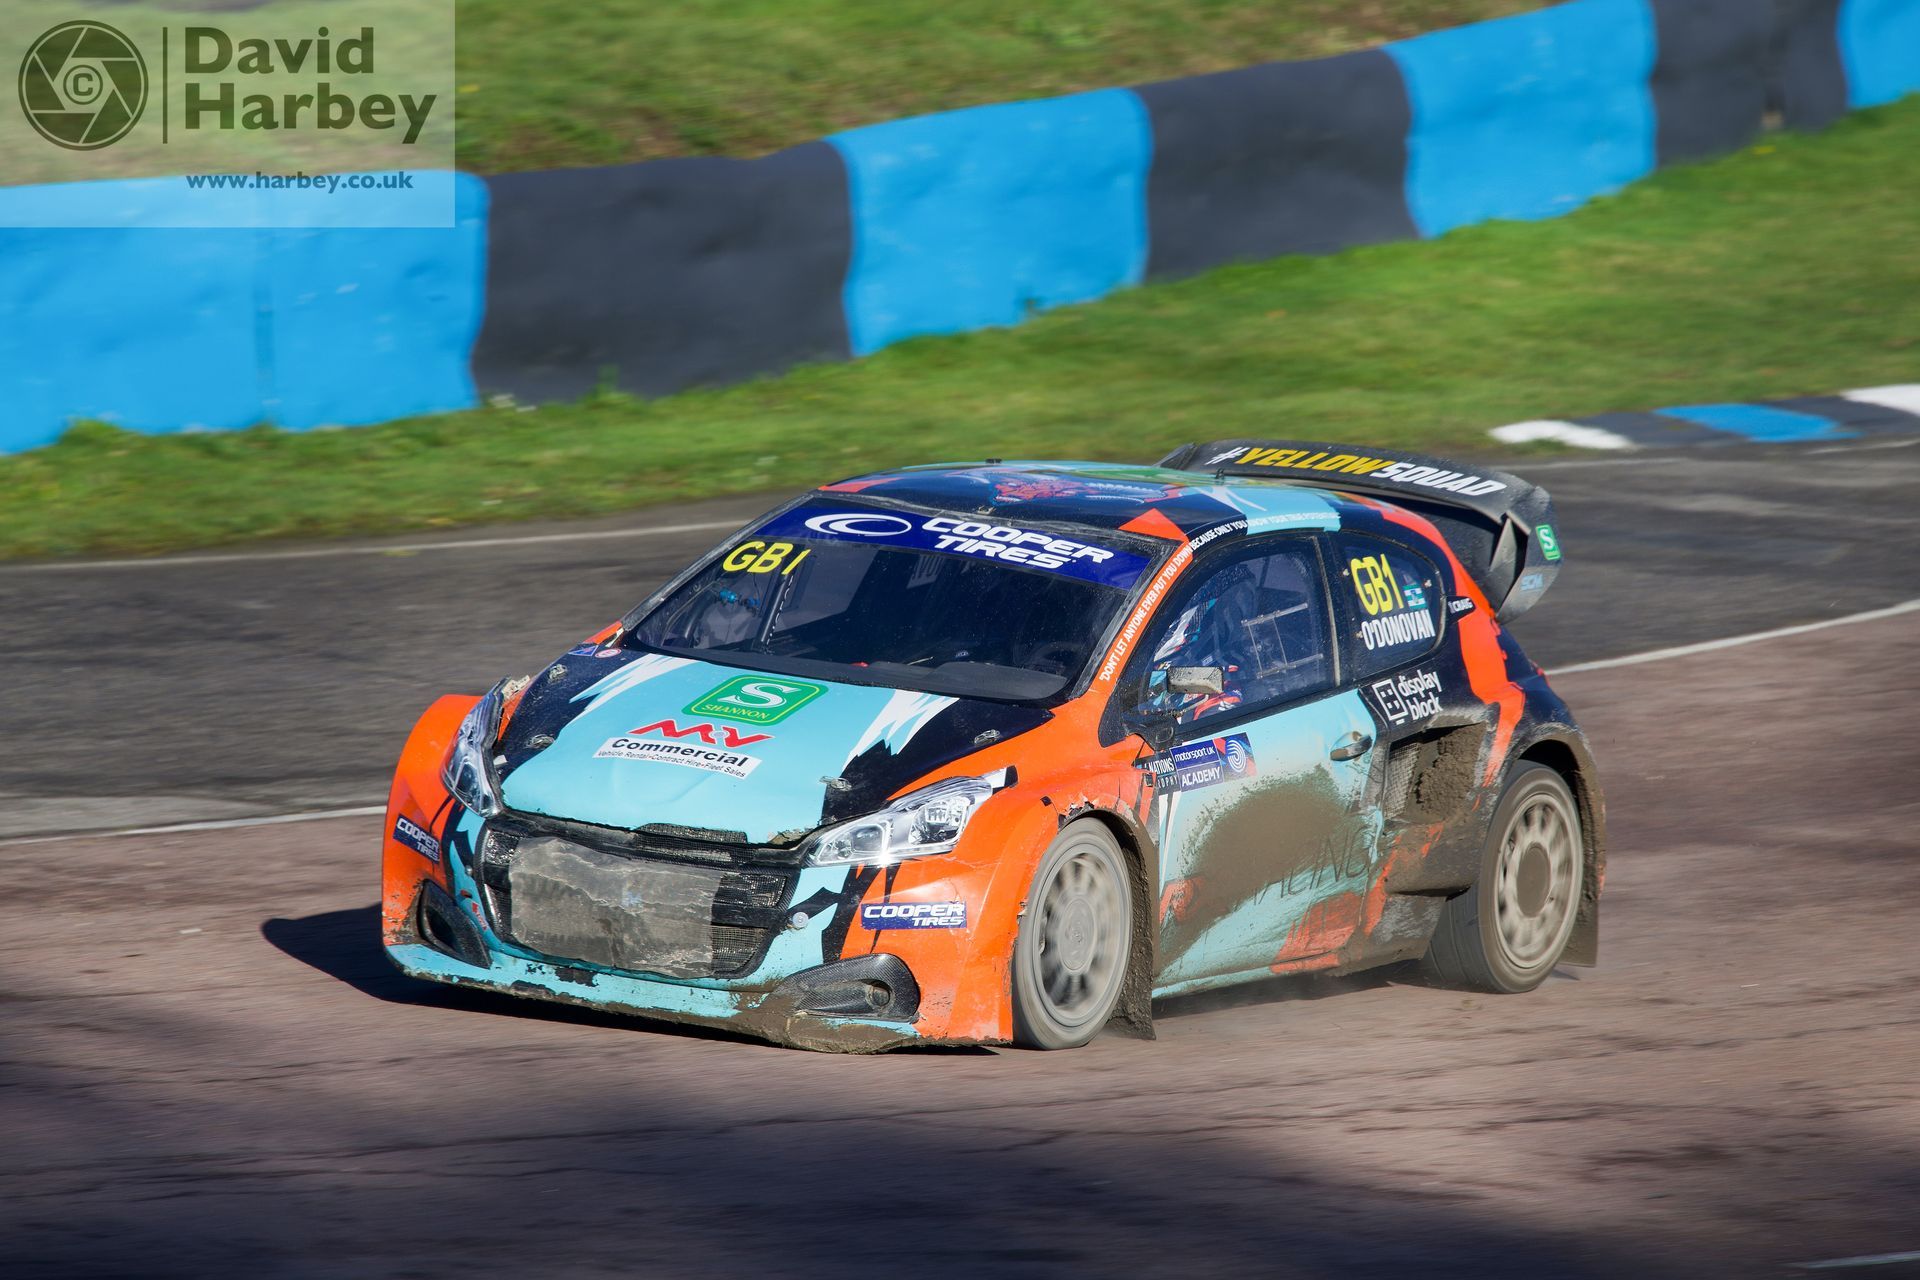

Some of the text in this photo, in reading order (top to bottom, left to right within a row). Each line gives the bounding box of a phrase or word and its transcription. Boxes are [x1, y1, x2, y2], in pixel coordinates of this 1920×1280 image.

[1205, 446, 1507, 496] #YELLOWSQUAD
[921, 517, 1115, 563] COOPER
[934, 534, 1072, 569] TIRES
[723, 541, 811, 575] GB1
[1114, 638, 1128, 657] LET
[1123, 607, 1147, 642] ANYONE
[1141, 588, 1158, 613] EVER
[1153, 575, 1167, 595] PUT
[1163, 562, 1178, 580] YOU
[1173, 544, 1194, 567] DOWN
[1189, 529, 1218, 550] BECAUSE
[1214, 523, 1233, 536] ONLY
[1229, 519, 1248, 530] YOU
[1351, 553, 1404, 616] GB1
[1361, 609, 1436, 650] O'DONOVAN
[1398, 669, 1442, 698] display
[702, 704, 771, 719] SHANNON
[1406, 692, 1444, 721] block
[612, 738, 749, 767] Commercial
[1149, 757, 1175, 774] NATIONS
[1174, 747, 1207, 762] motorsport
[724, 766, 746, 778] Sales
[1182, 766, 1220, 787] ACADEMY
[396, 818, 440, 852] COOPER
[416, 842, 439, 861] TIRES
[863, 904, 966, 918] COOPER
[911, 916, 966, 927] TIRES
